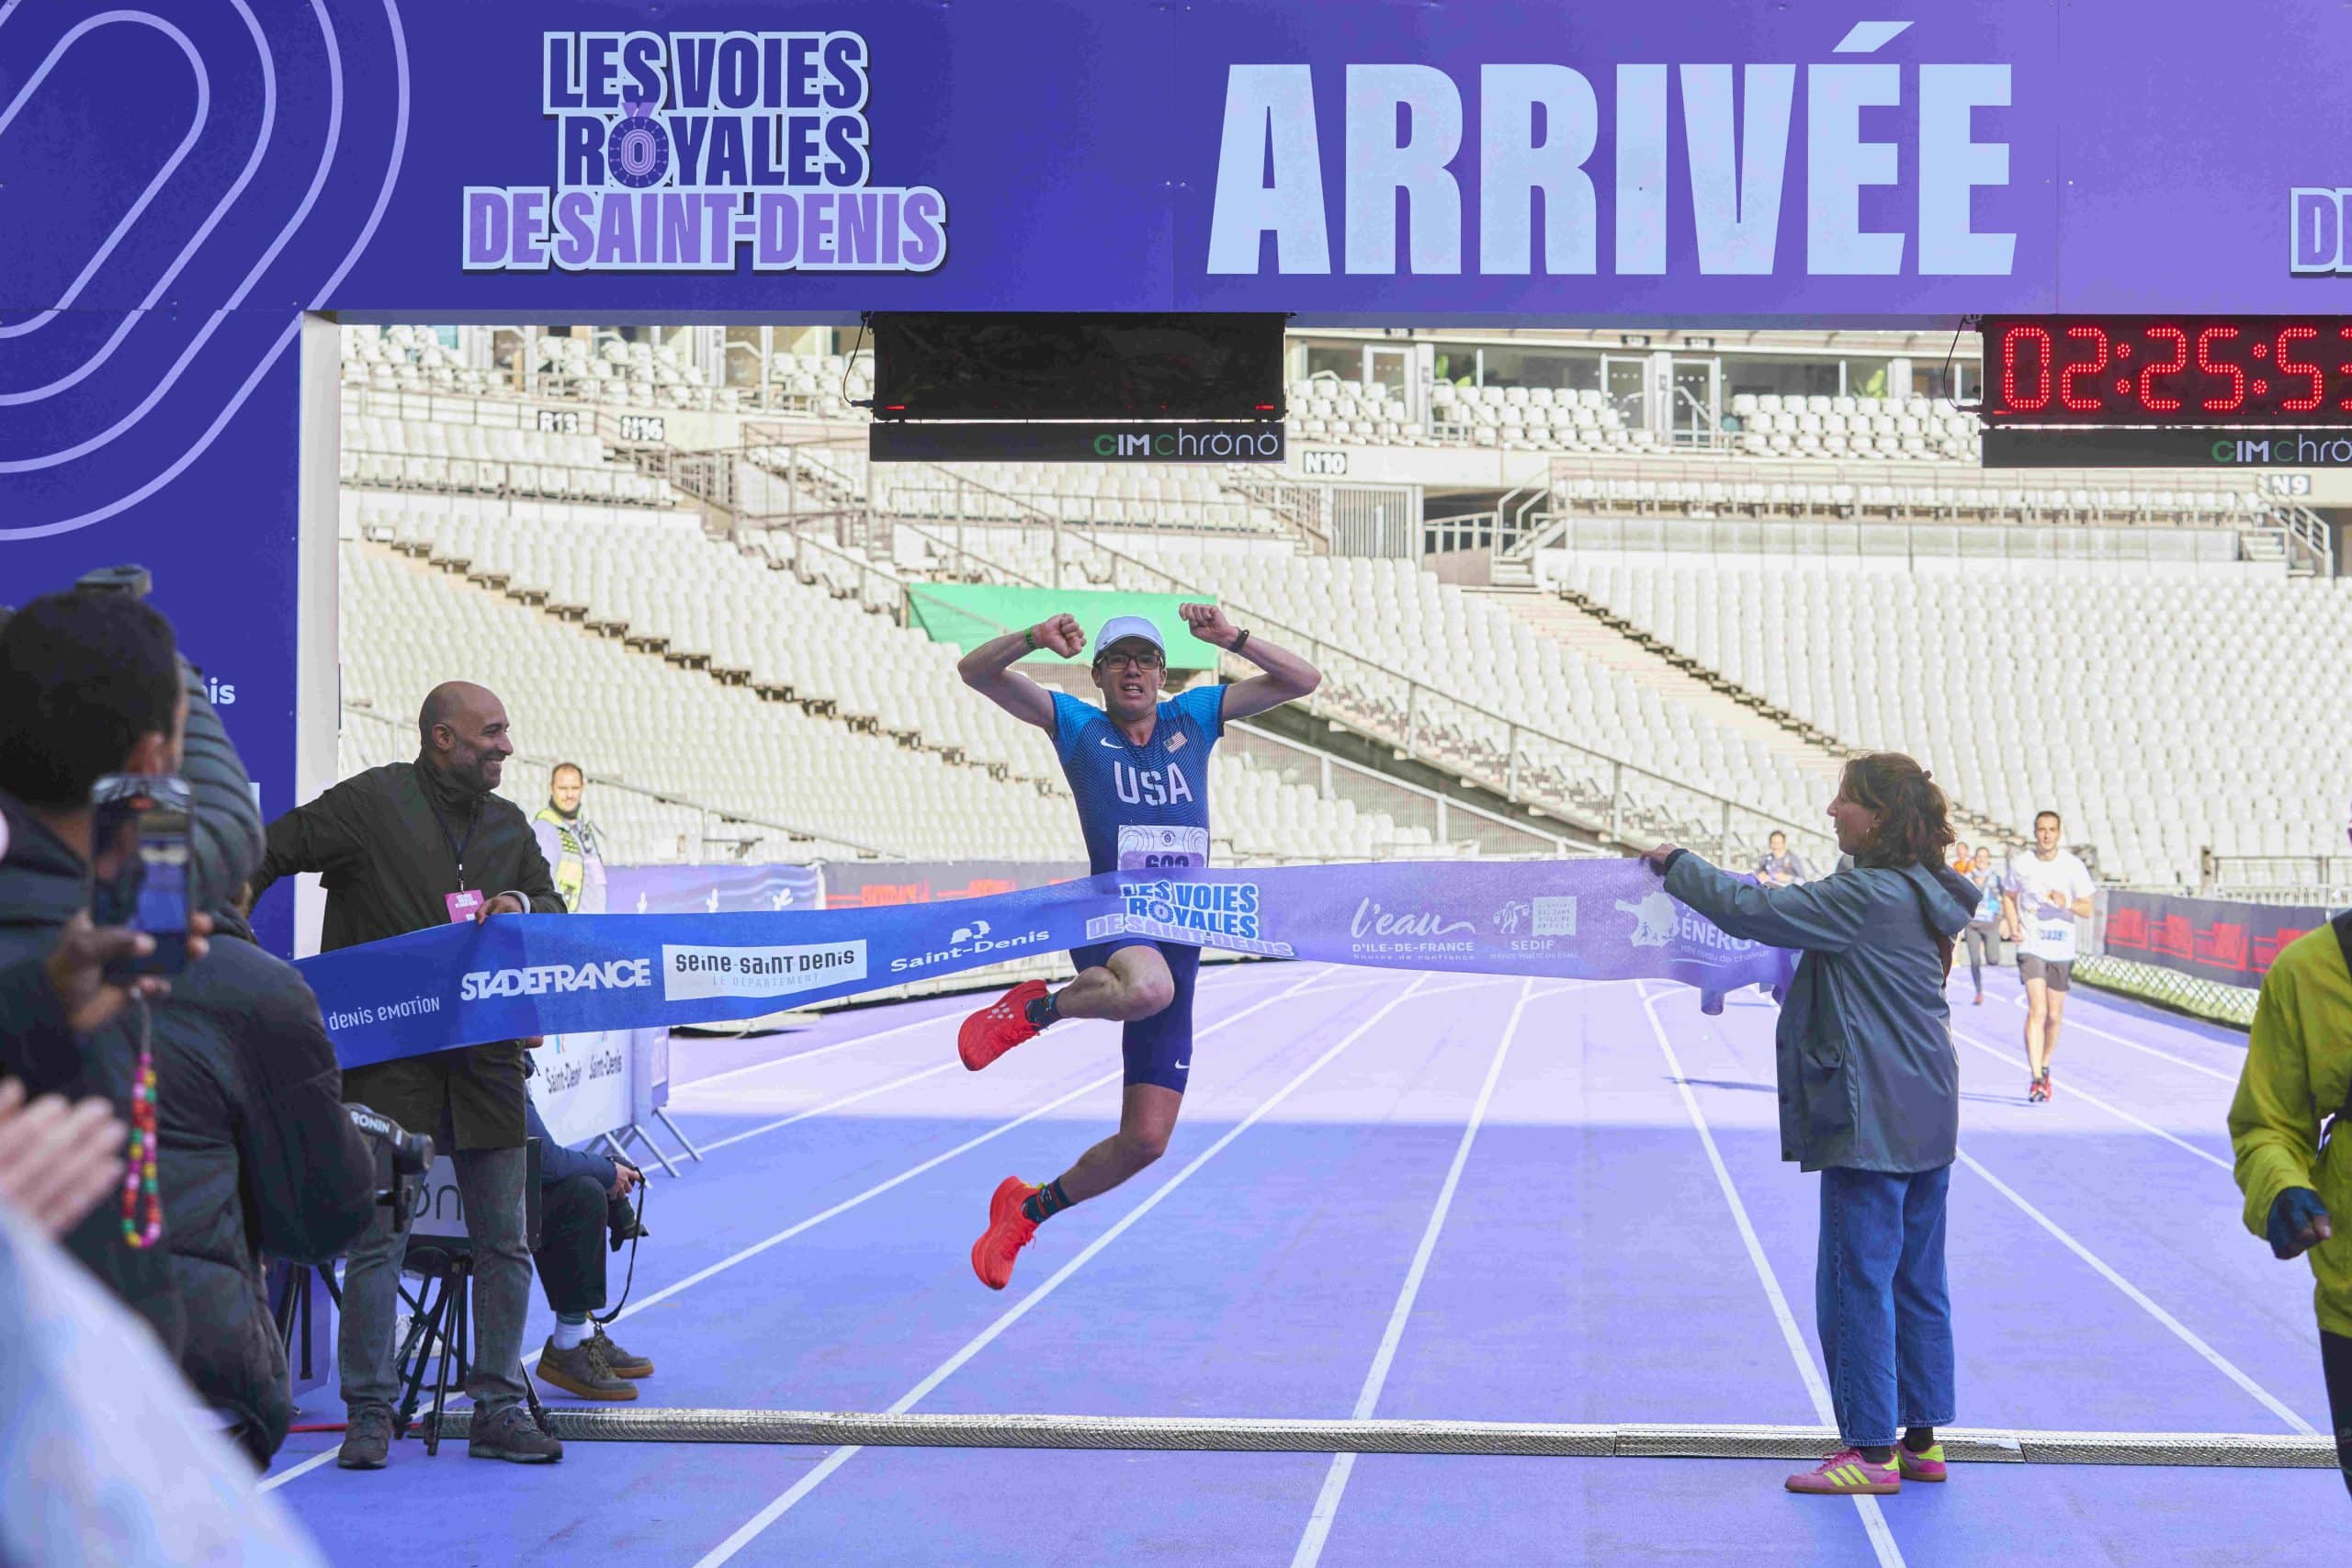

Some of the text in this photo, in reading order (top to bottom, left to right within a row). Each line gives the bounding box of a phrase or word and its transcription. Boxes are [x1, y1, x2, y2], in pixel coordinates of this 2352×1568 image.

[544, 30, 868, 113] LES VOIES
[559, 112, 869, 188] ROYALES
[1206, 21, 2017, 275] ARRIVÉE
[463, 186, 946, 270] DE SAINT-DENIS
[2290, 187, 2352, 272] D
[1305, 453, 1347, 475] N10
[2270, 474, 2309, 495] N9
[1113, 761, 1193, 807] USA
[1120, 879, 1260, 913] LES VOIES
[1086, 913, 1295, 956] DE SAINT-DENIS
[1127, 897, 1259, 940] ROYALES
[890, 930, 1050, 973] Saint-Denis
[1511, 940, 1555, 951] SEDIF
[350, 1111, 390, 1134] RONIN
